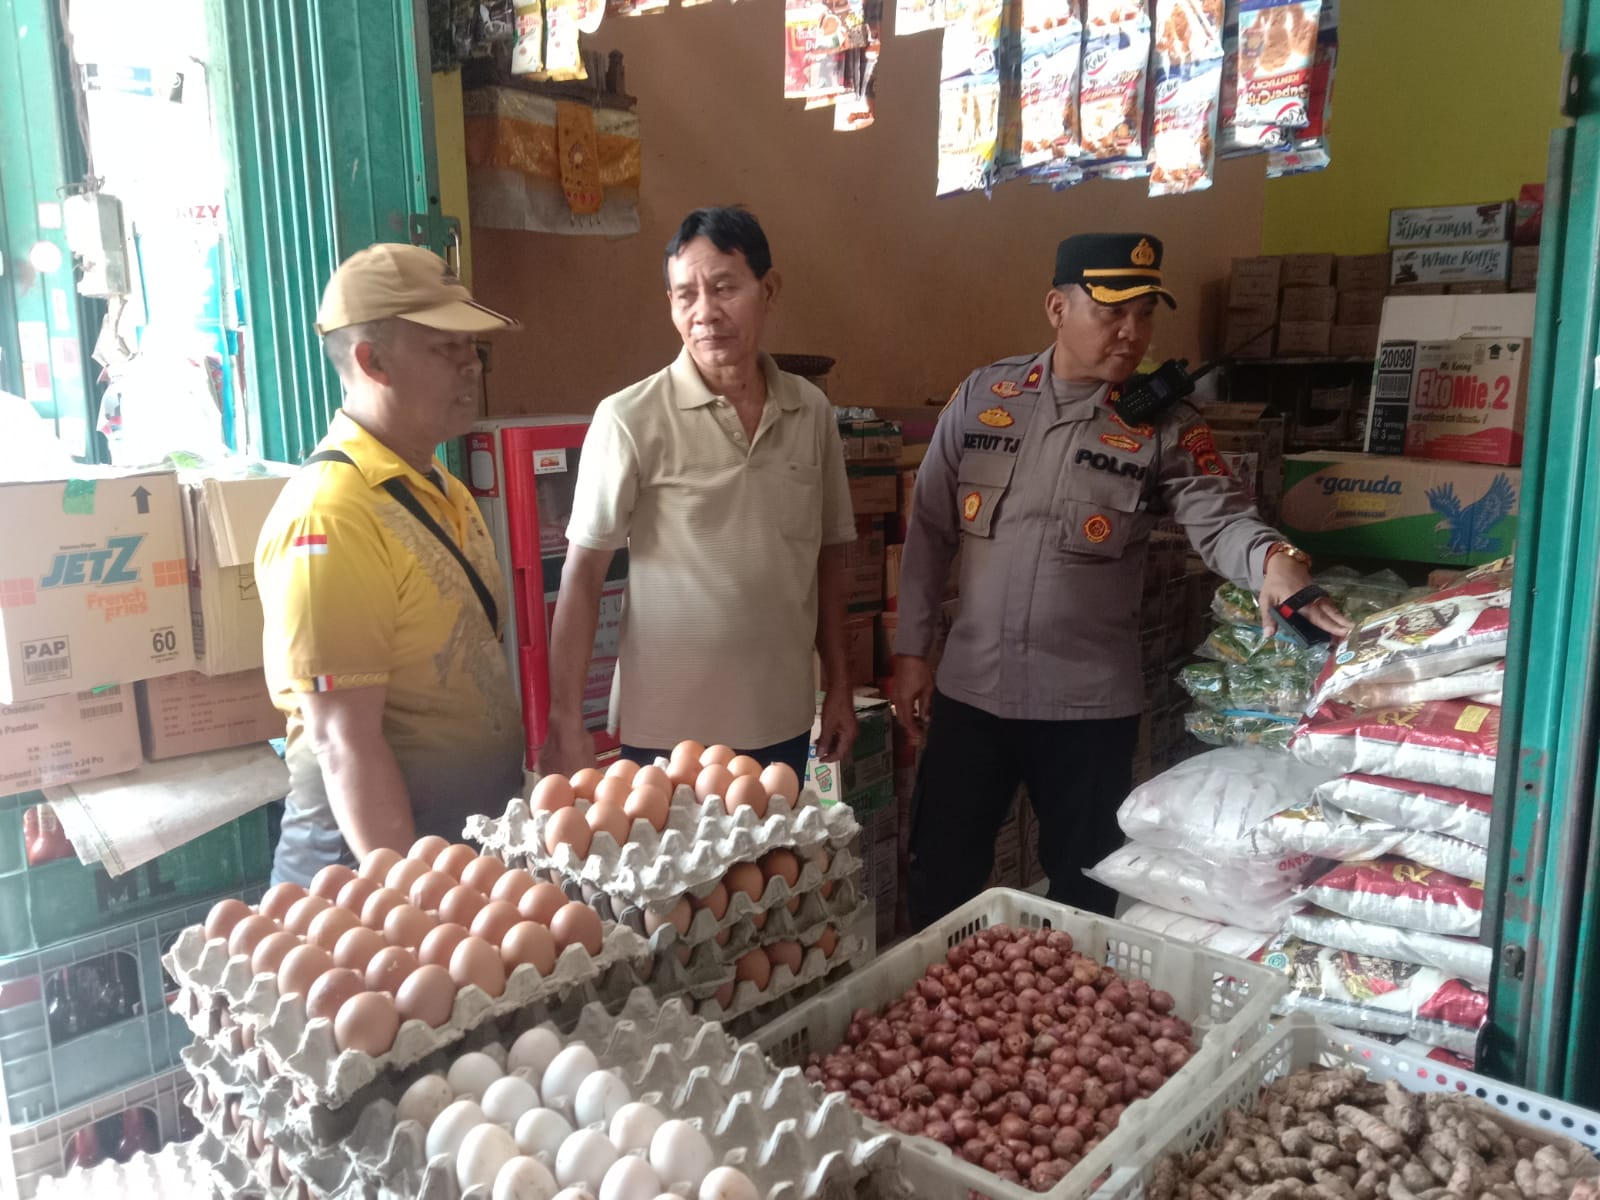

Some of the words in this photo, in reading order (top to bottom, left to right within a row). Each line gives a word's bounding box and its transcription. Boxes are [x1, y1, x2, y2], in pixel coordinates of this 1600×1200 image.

[1421, 251, 1458, 268] White
[1460, 248, 1501, 267] Koffie
[1381, 349, 1412, 369] 20098
[964, 432, 1003, 451] KETUT
[1075, 448, 1147, 481] POLRI
[1323, 475, 1402, 495] garuda
[40, 534, 145, 589] JETZ
[24, 640, 66, 659] PAP
[152, 630, 176, 653] 60
